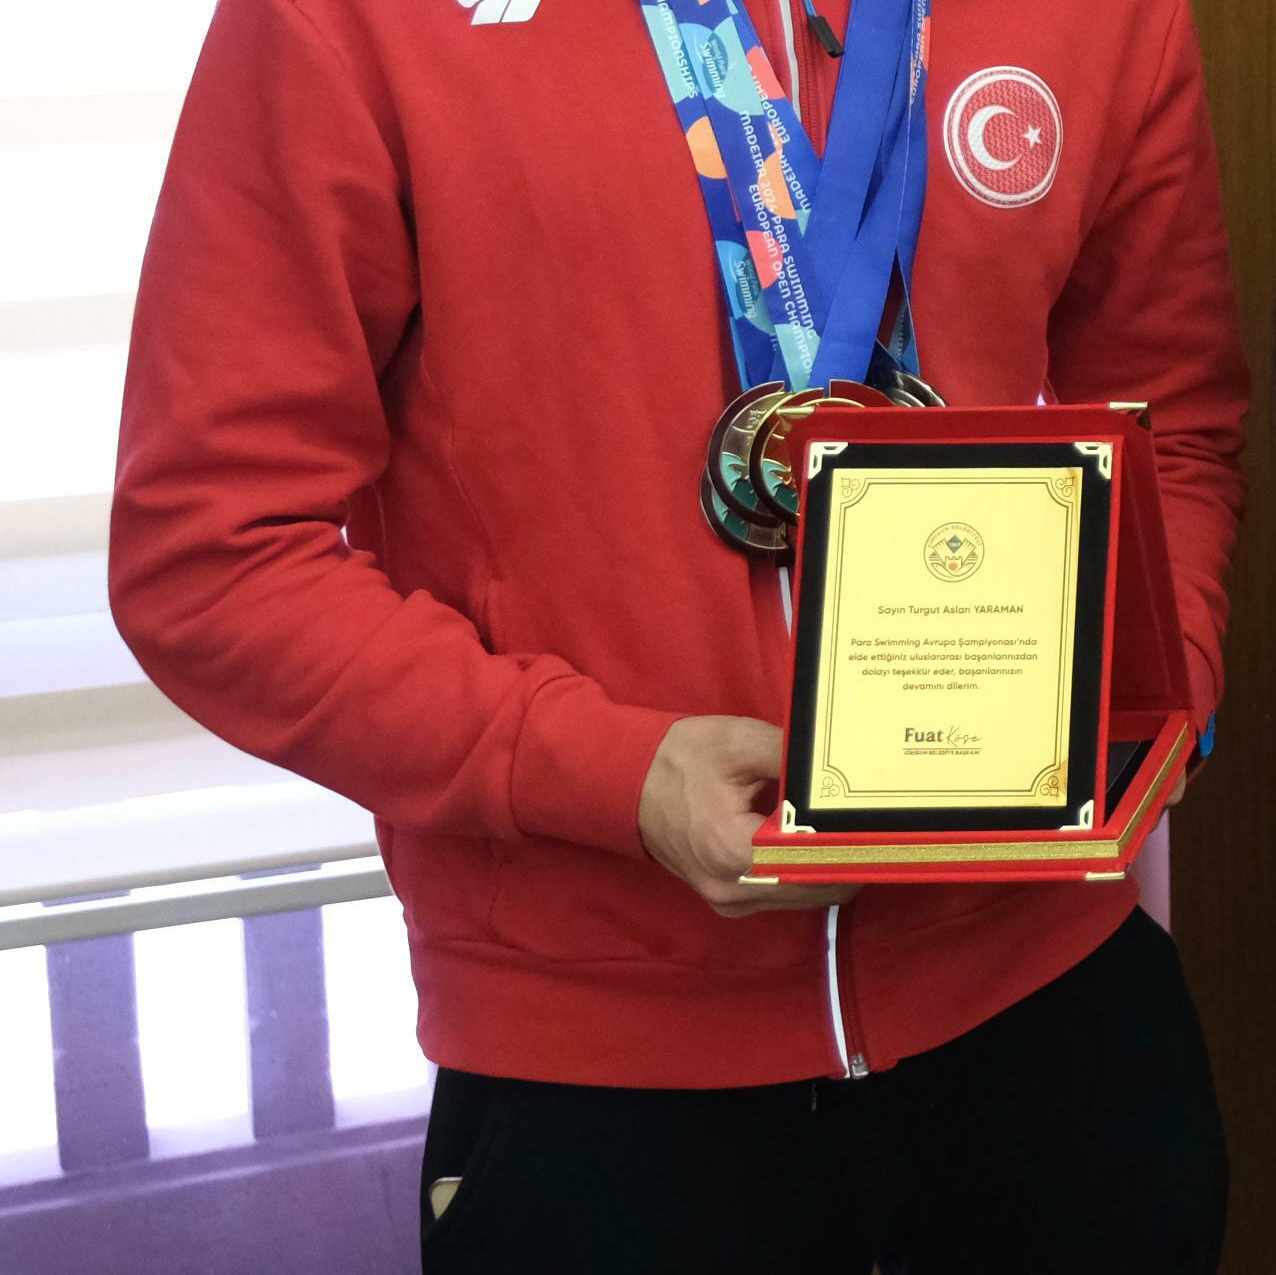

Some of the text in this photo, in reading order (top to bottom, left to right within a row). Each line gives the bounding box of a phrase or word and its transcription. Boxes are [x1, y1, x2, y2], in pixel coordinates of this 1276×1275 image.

[702, 41, 726, 99] Swimming
[740, 111, 768, 179] MADEIRA
[772, 215, 790, 254] PARA
[783, 256, 816, 339] SWIMMING
[749, 184, 814, 373] EUROPEAN OPEN CHAMPIO
[735, 260, 757, 318] Swimming
[878, 604, 1024, 616] Sayın Turgut Aslan YARAMAN
[851, 638, 872, 646] Para
[874, 638, 920, 648] Swimming
[922, 638, 956, 648] Avrupa
[848, 653, 868, 661] elde
[870, 652, 907, 663] ettiğiniz
[862, 667, 890, 677] dolayı
[892, 667, 930, 678] teşekkür
[902, 681, 980, 690] devamını dilerim.
[904, 726, 944, 743] Fuat
